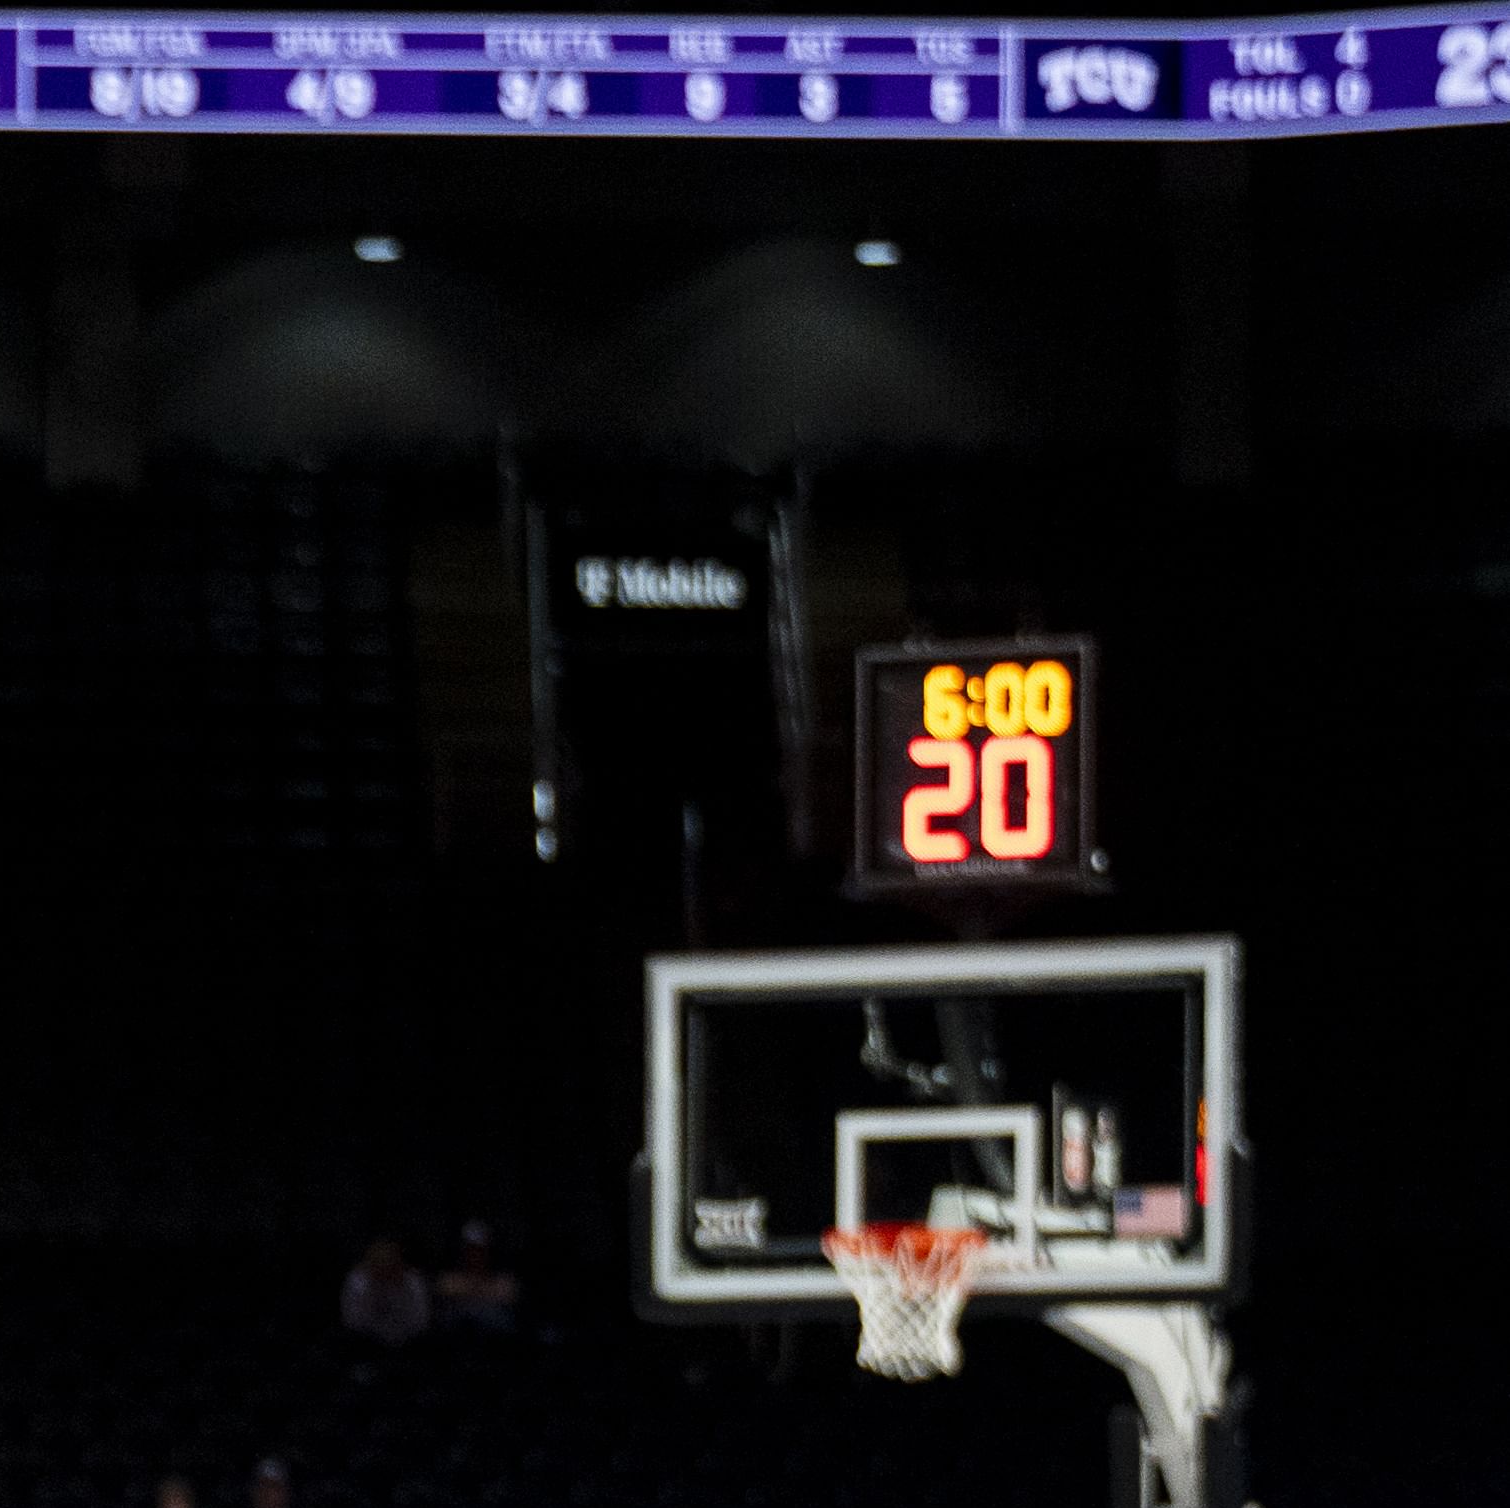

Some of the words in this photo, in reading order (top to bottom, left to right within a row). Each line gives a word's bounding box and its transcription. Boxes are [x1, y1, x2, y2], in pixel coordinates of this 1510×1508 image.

[1336, 27, 1369, 66] 4
[1039, 47, 1159, 112] TCU
[1208, 75, 1329, 121] FOULS
[1336, 69, 1371, 116] 0
[924, 660, 1072, 740] 6:00
[902, 734, 1054, 862] 20
